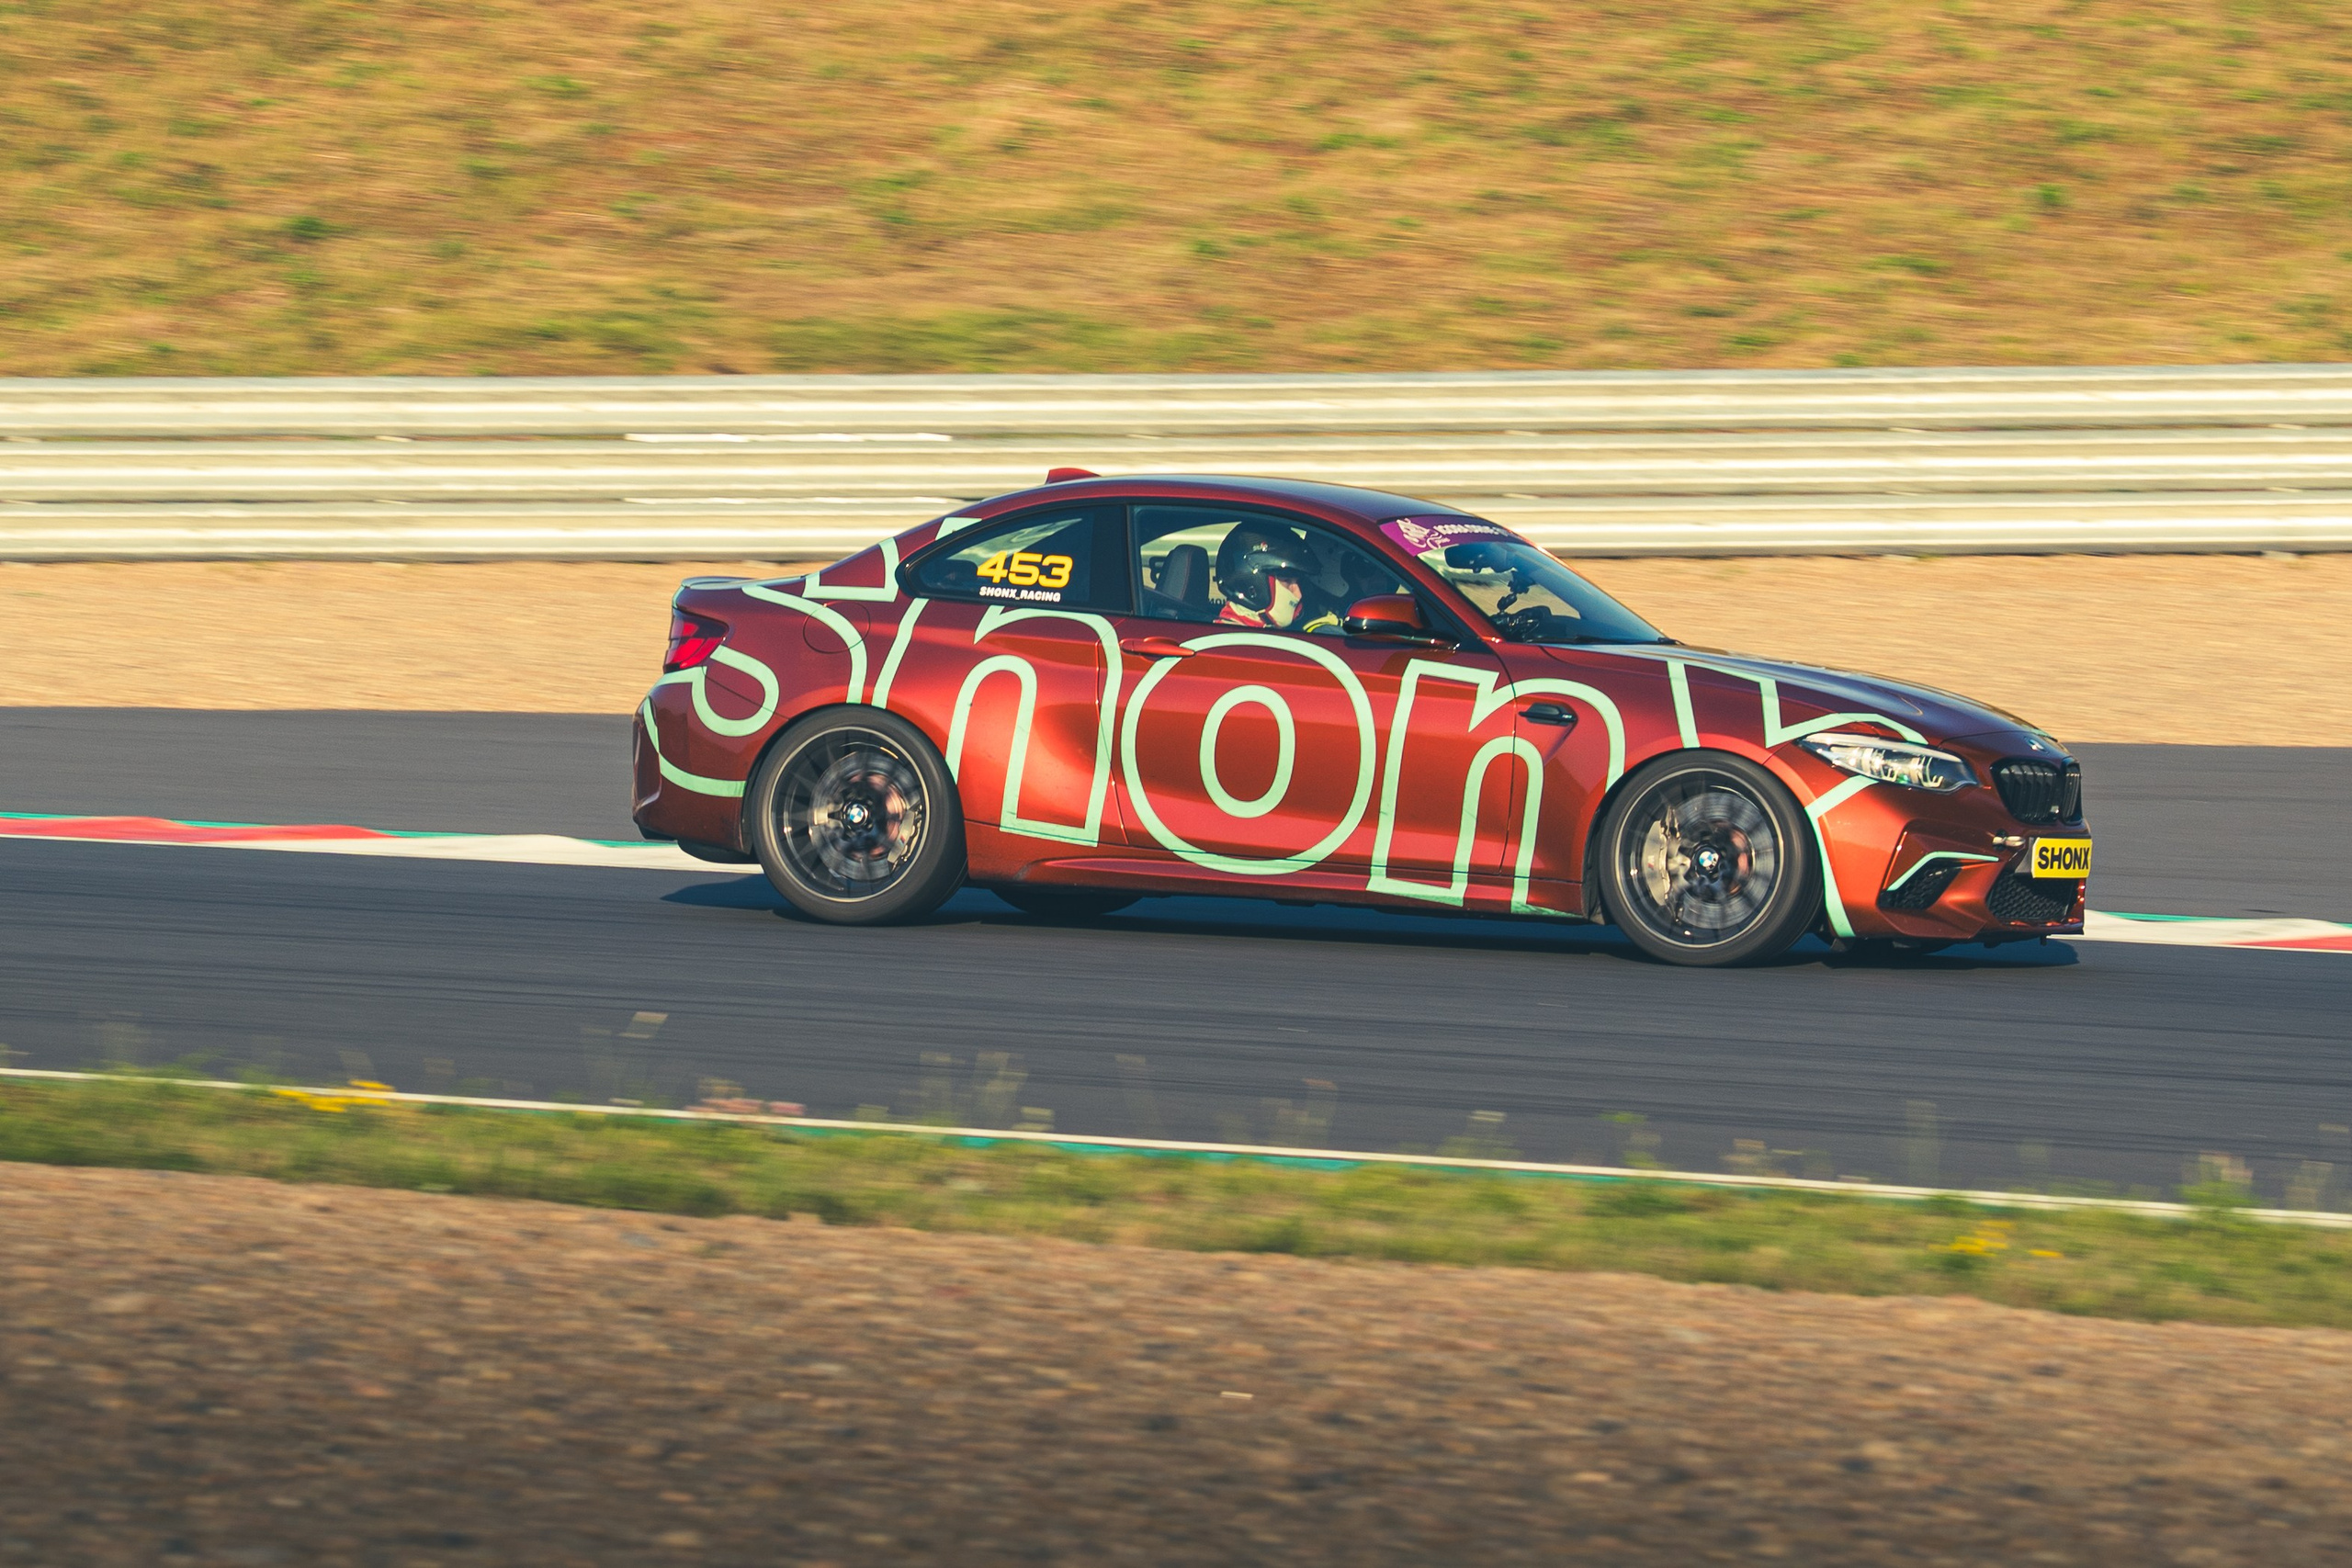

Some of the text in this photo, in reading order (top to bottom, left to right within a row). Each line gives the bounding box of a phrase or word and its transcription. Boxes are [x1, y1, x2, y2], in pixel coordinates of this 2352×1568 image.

[976, 550, 1074, 589] 453
[978, 586, 1062, 603] SHONX_RACING
[2037, 846, 2090, 870] SHONX
